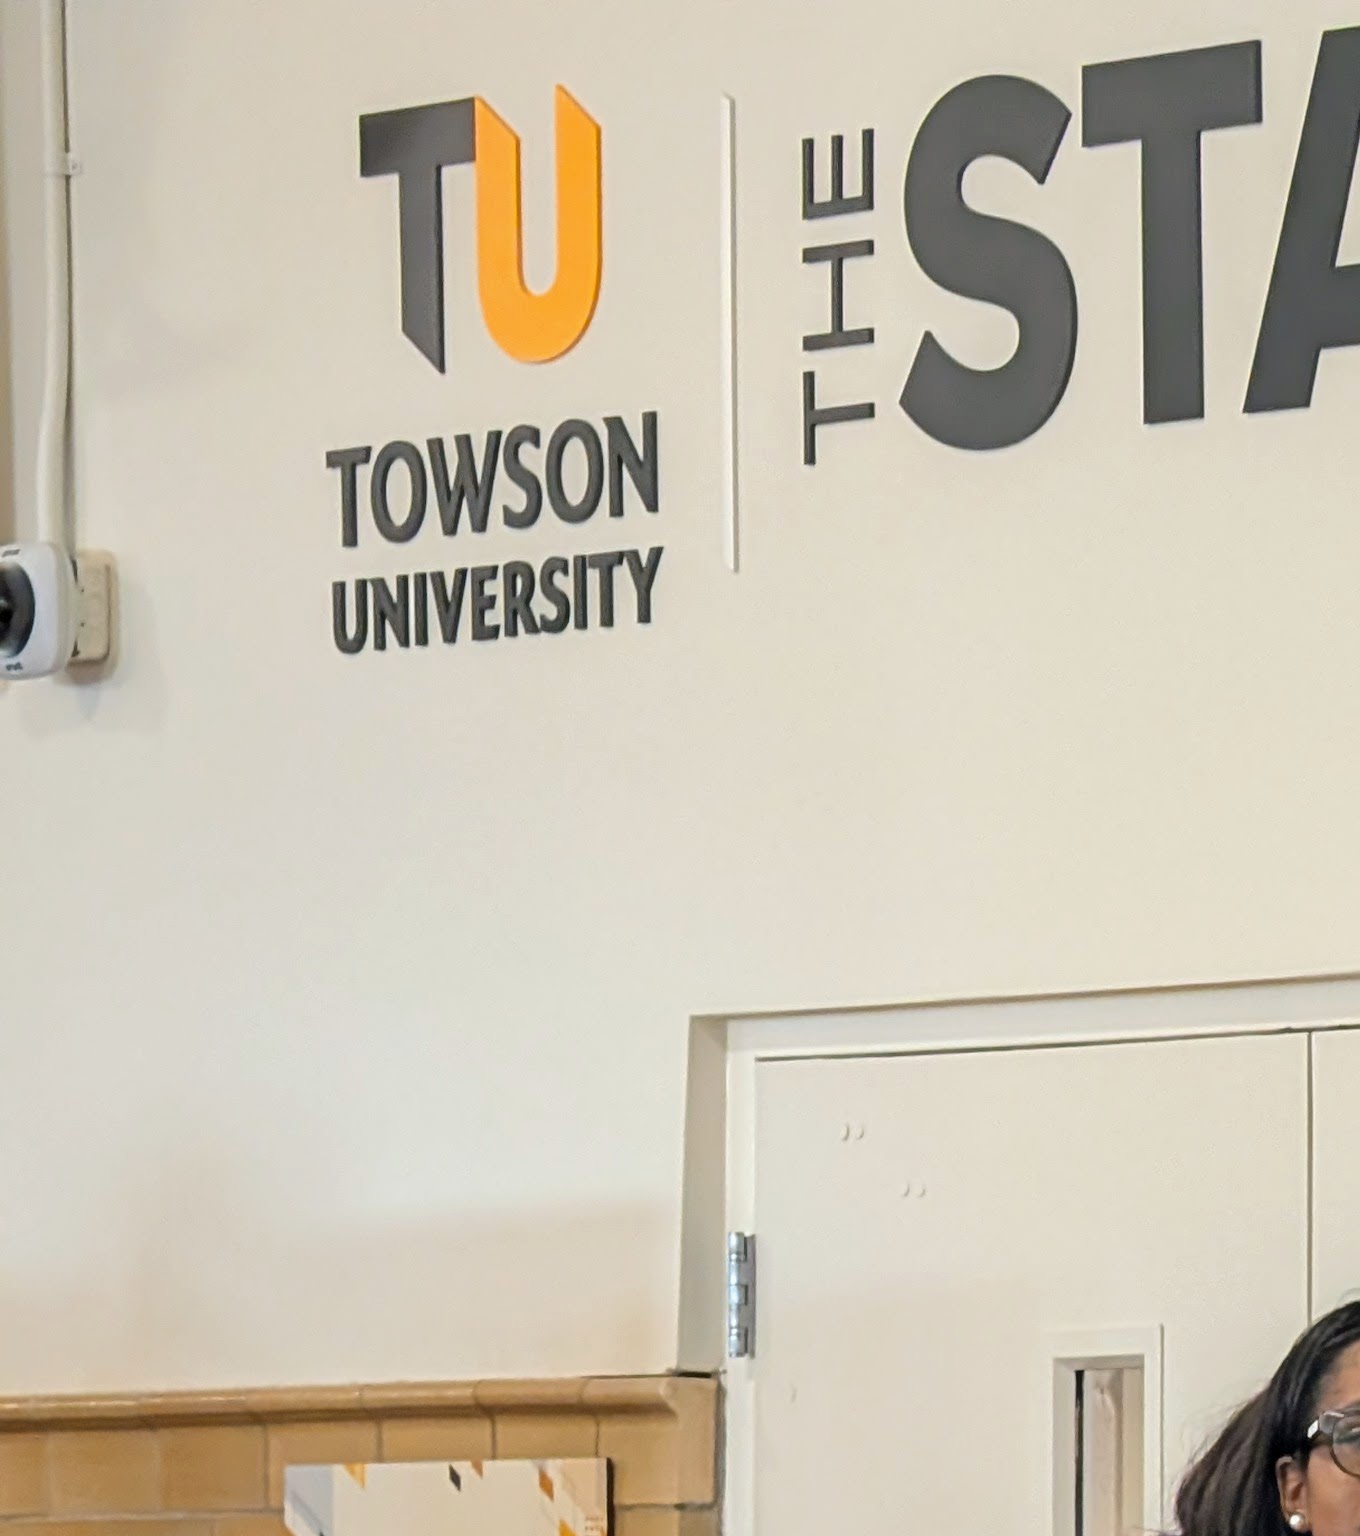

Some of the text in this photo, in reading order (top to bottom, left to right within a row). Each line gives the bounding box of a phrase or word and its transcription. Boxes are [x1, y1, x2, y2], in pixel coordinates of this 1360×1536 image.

[359, 84, 602, 374] TU
[801, 128, 875, 466] THE
[325, 410, 660, 548] TOWSON
[331, 546, 664, 655] UNIVERSITY
